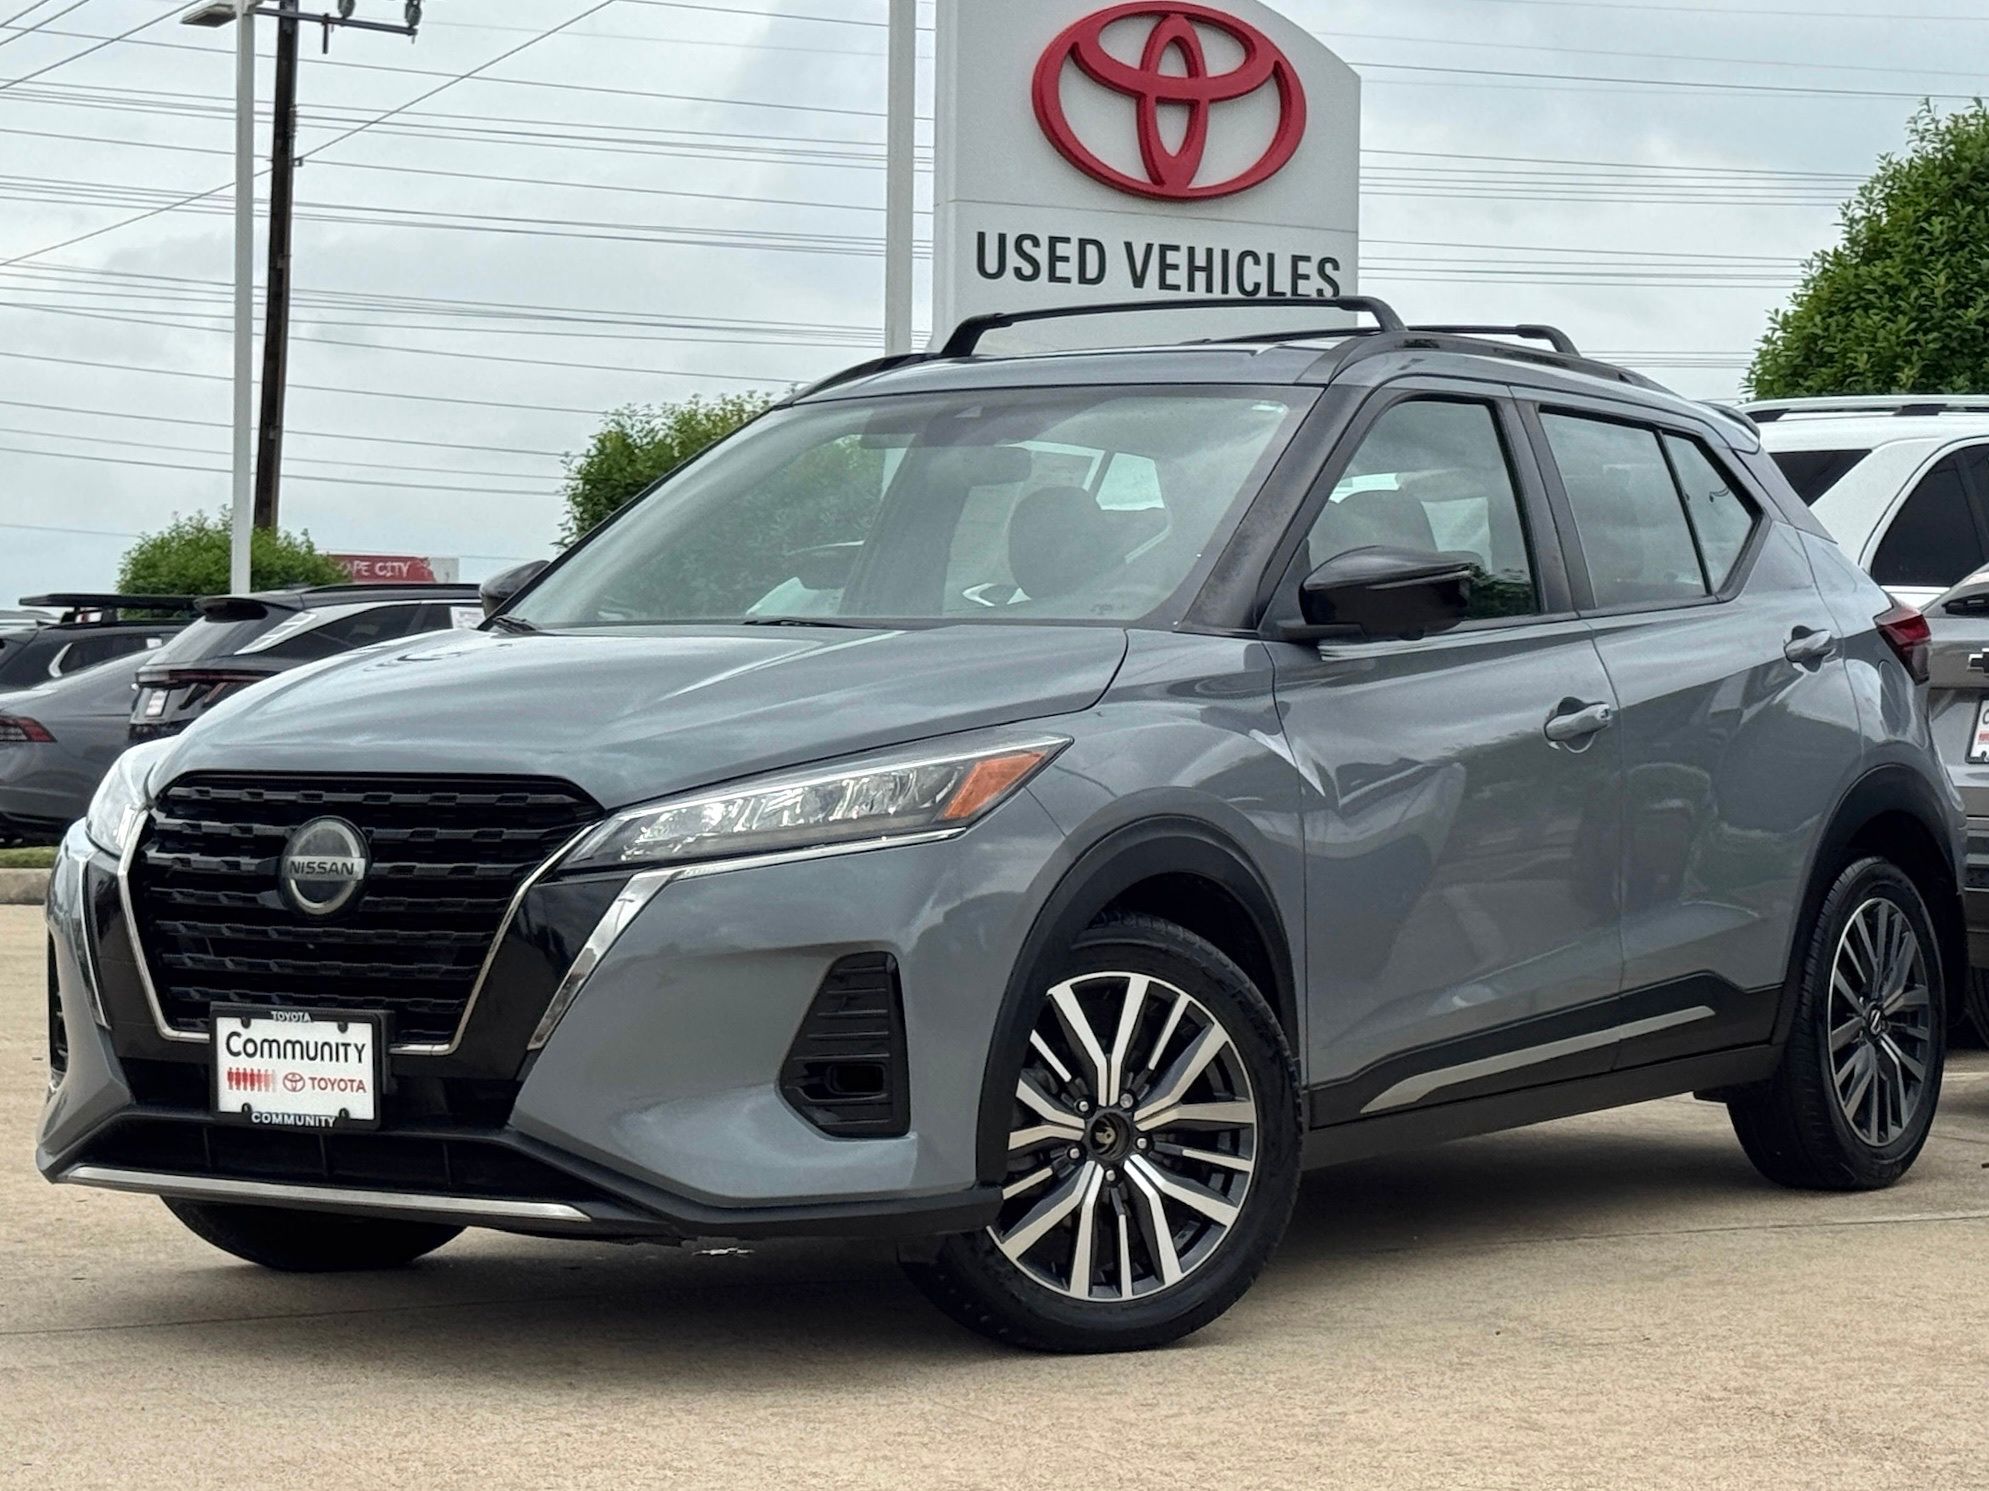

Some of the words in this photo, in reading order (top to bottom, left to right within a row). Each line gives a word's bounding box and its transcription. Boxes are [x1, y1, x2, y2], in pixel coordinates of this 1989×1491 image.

[976, 231, 1106, 286] USED
[1124, 241, 1340, 299] VEHICLES
[375, 562, 411, 577] CITY
[289, 860, 354, 875] NISSAN
[271, 1011, 312, 1023] TOYOTA
[308, 1076, 367, 1093] TOYOTA
[251, 1112, 336, 1128] COMMUNITY
